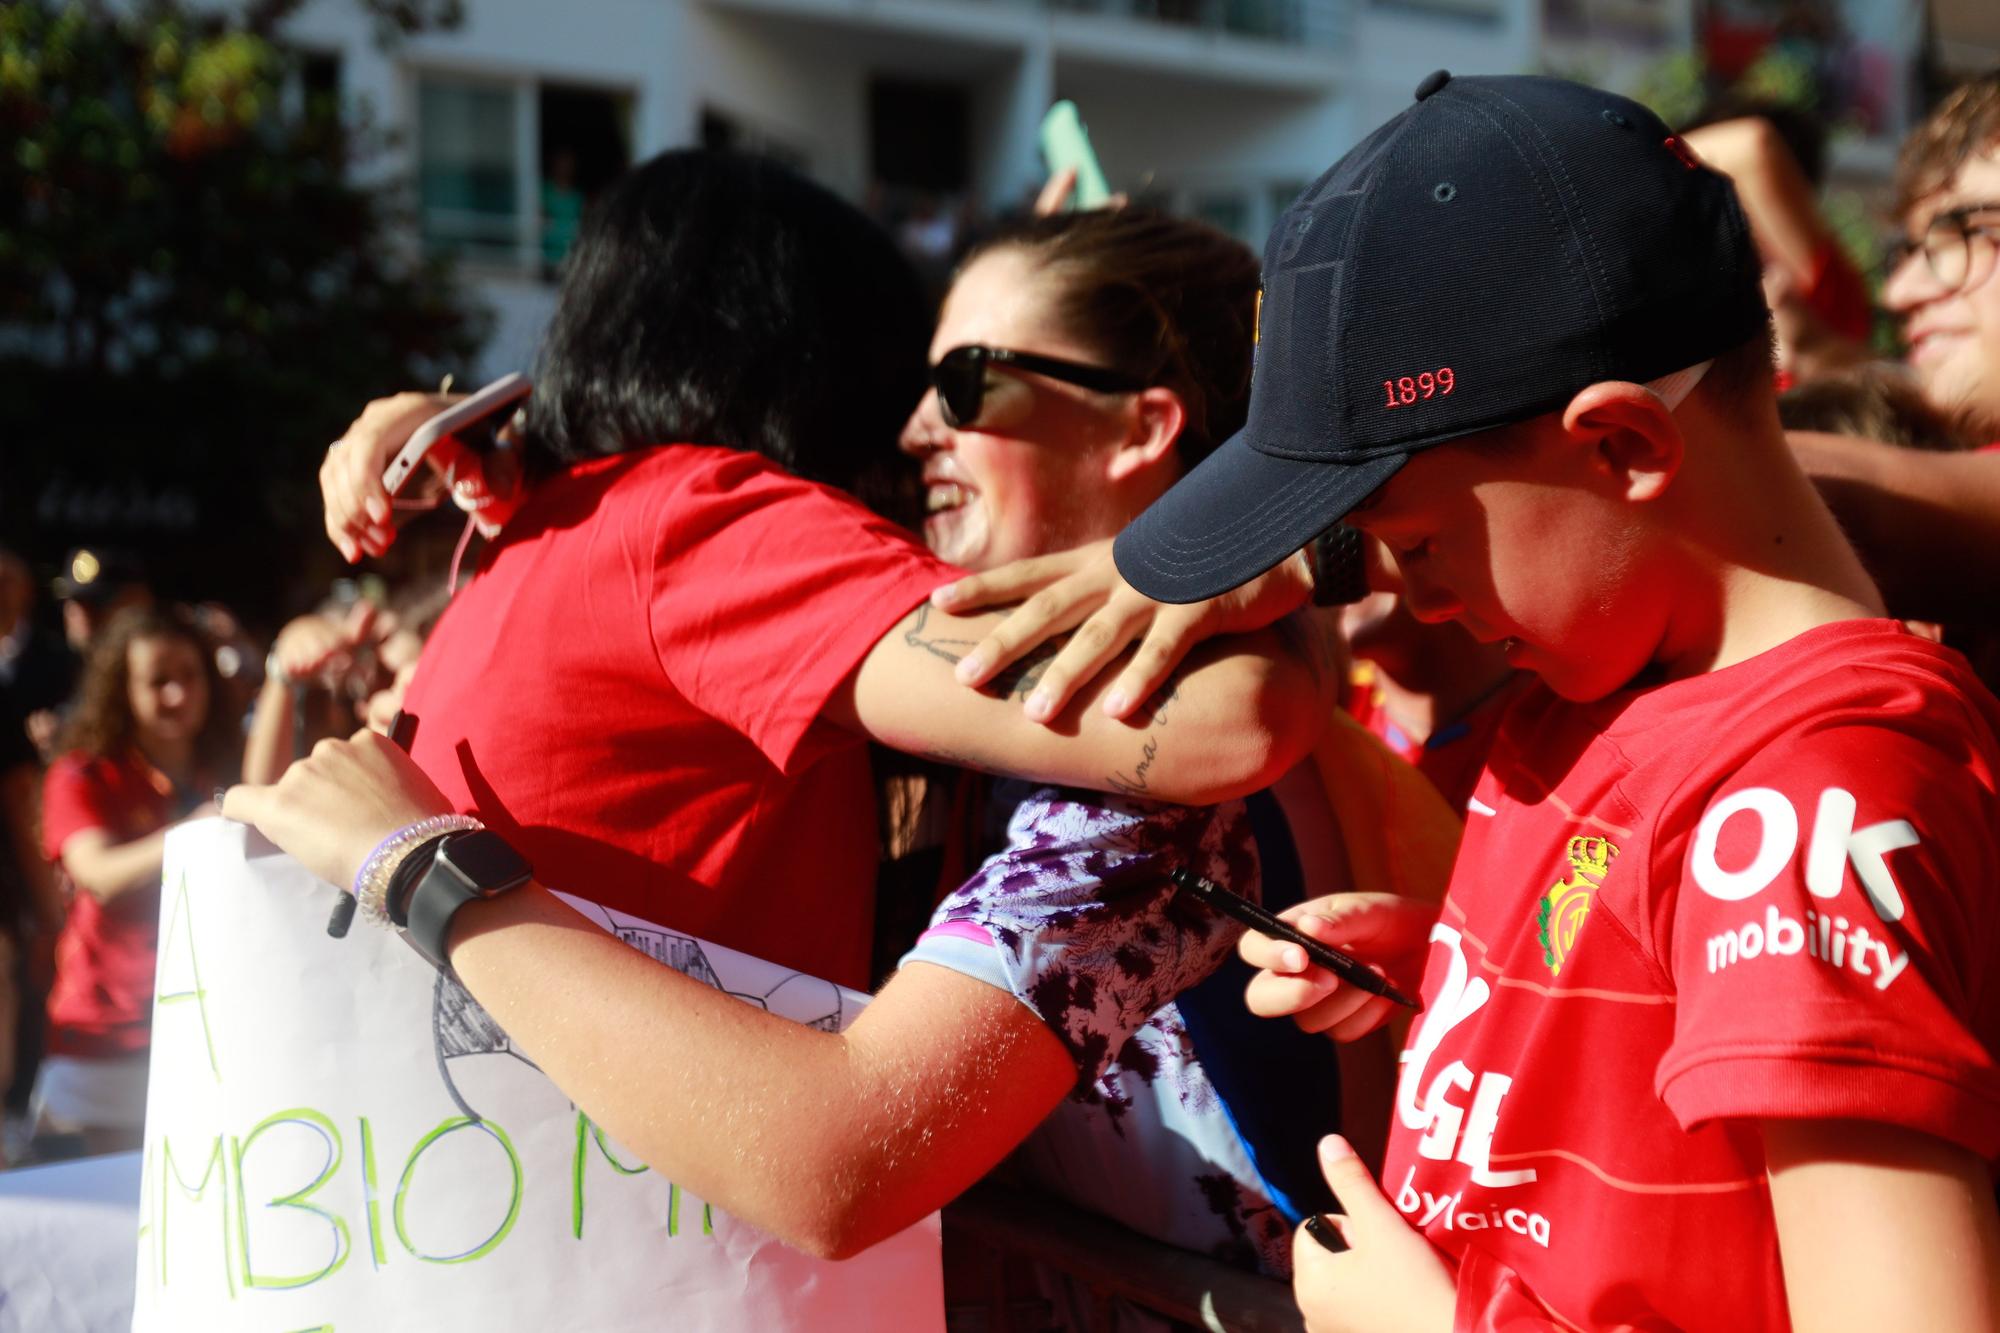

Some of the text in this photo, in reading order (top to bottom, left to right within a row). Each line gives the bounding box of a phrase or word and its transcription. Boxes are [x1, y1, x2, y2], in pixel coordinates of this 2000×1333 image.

[1383, 367, 1454, 409] 1899
[1691, 787, 1920, 921] OK
[1707, 905, 1909, 990] mobility
[1395, 1164, 1452, 1227] by
